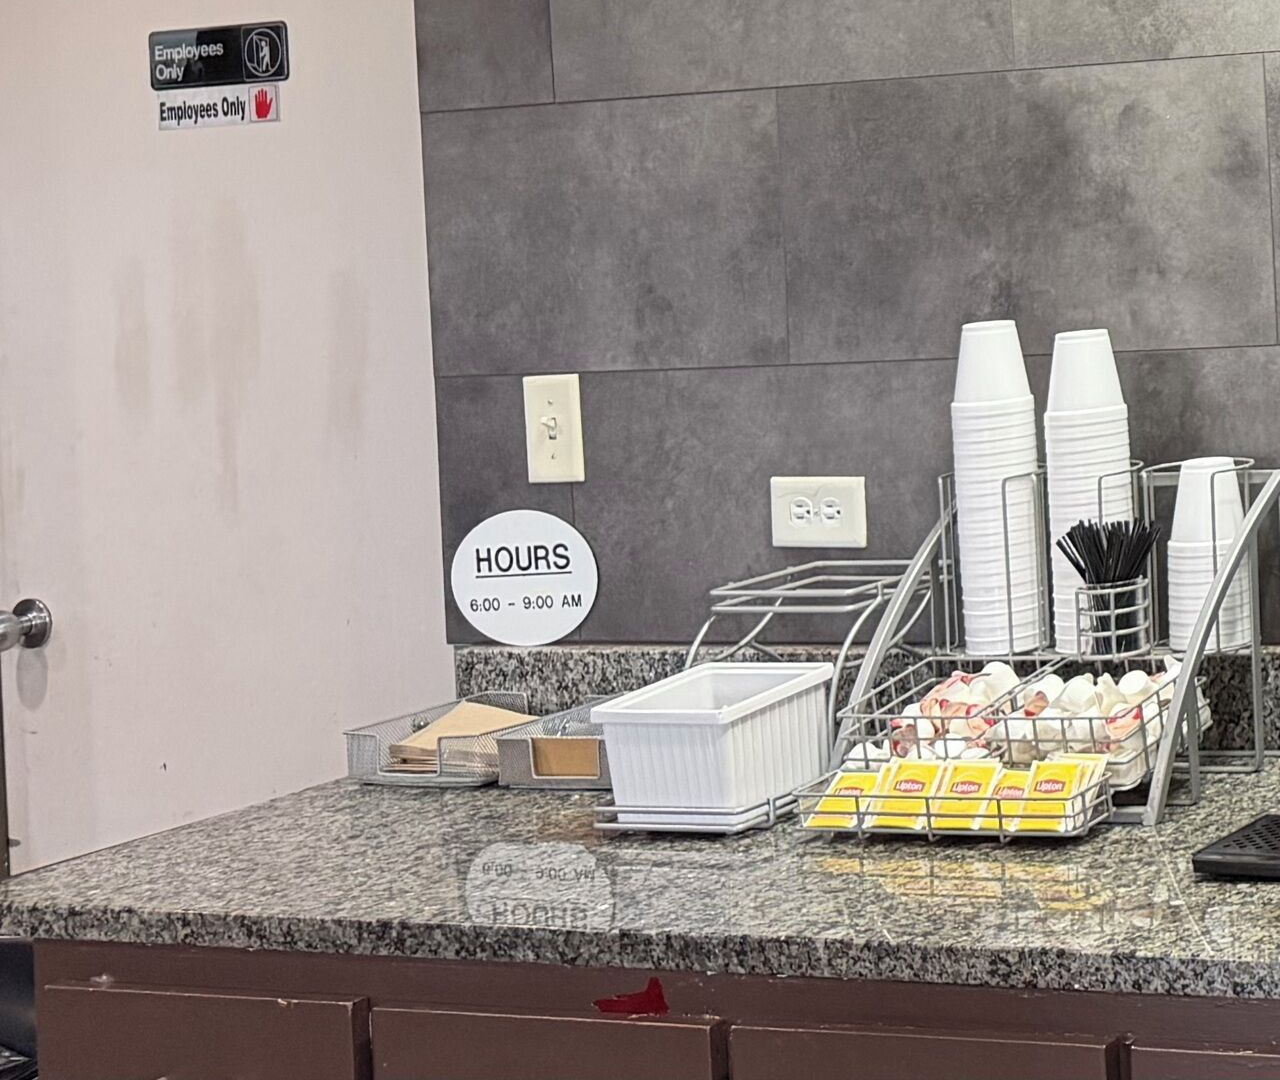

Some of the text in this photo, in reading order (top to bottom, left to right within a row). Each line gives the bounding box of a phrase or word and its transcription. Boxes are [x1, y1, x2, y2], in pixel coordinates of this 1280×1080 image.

[154, 43, 224, 62] Employees
[156, 64, 185, 82] Only
[159, 96, 246, 126] Employees Only
[475, 543, 571, 573] HOURS
[470, 598, 500, 612] 6:00
[522, 595, 554, 610] 9:00
[562, 594, 582, 608] AM
[896, 781, 923, 792] Lipton
[952, 782, 979, 794] Lipton
[1036, 782, 1063, 792] Lipton
